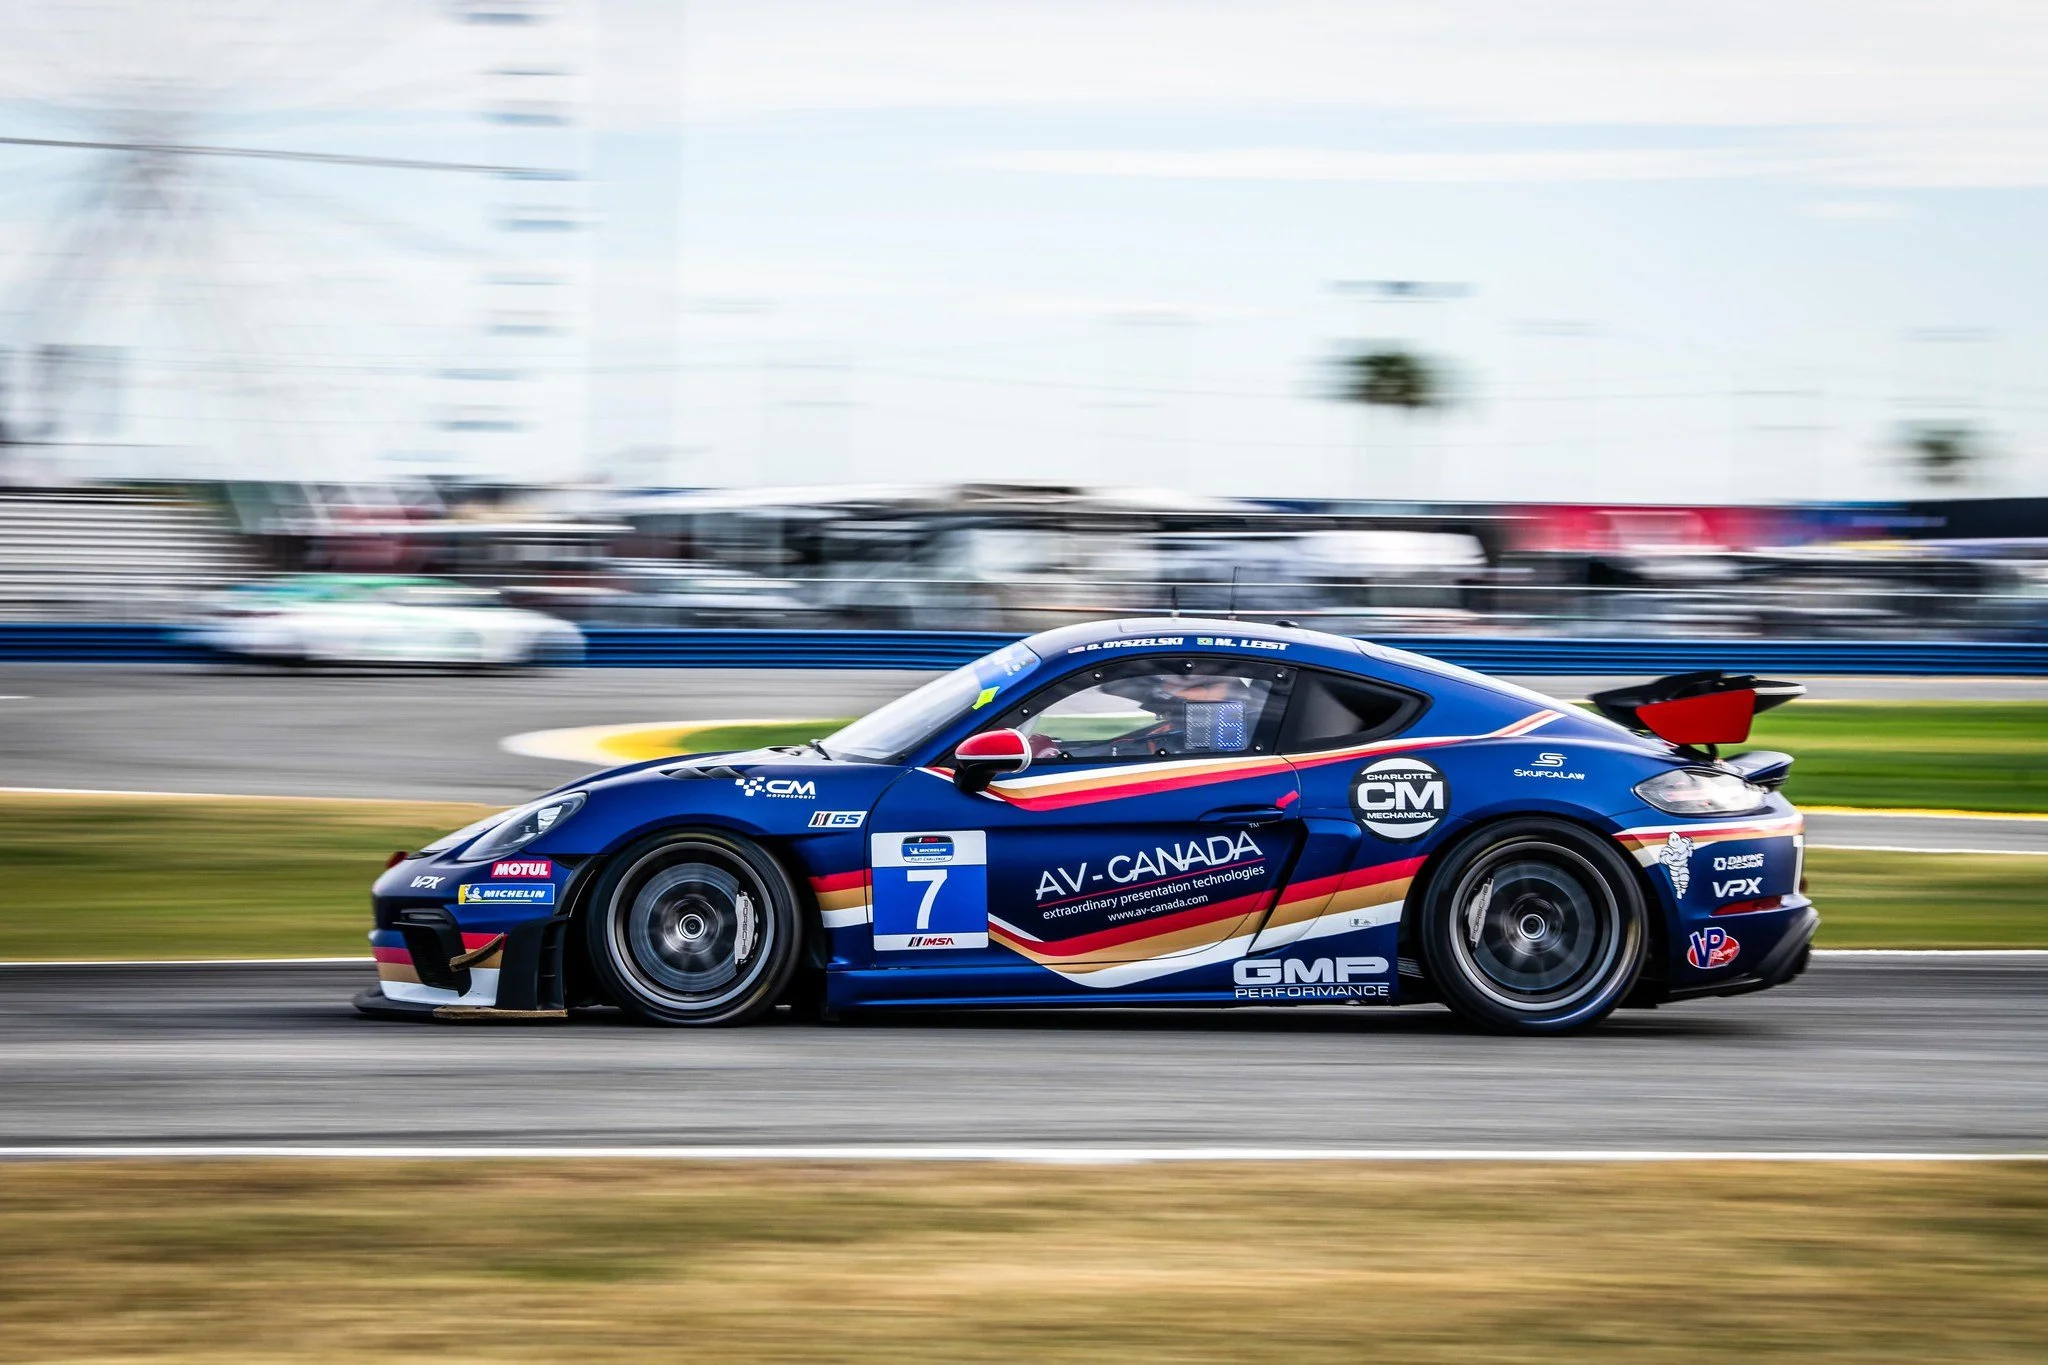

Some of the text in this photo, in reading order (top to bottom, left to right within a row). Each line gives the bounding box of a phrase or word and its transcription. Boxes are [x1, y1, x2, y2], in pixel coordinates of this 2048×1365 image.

[1214, 638, 1290, 650] M. LEIST
[766, 780, 816, 795] CM
[1357, 781, 1444, 810] CM
[831, 814, 862, 825] GS
[494, 863, 549, 876] MOTUL
[1035, 830, 1264, 901] AV-CANADA
[410, 876, 446, 889] VPX
[1712, 877, 1763, 898] VPX
[483, 890, 545, 898] MICHELIN
[906, 869, 948, 930] 7
[1042, 865, 1265, 920] extraordinary presentation technologies
[1107, 893, 1209, 922] www.av-canada.com
[922, 937, 955, 946] IMSA
[1688, 926, 1728, 968] VP
[1233, 956, 1389, 985] GMP
[1235, 985, 1389, 998] PERFORMANCE
